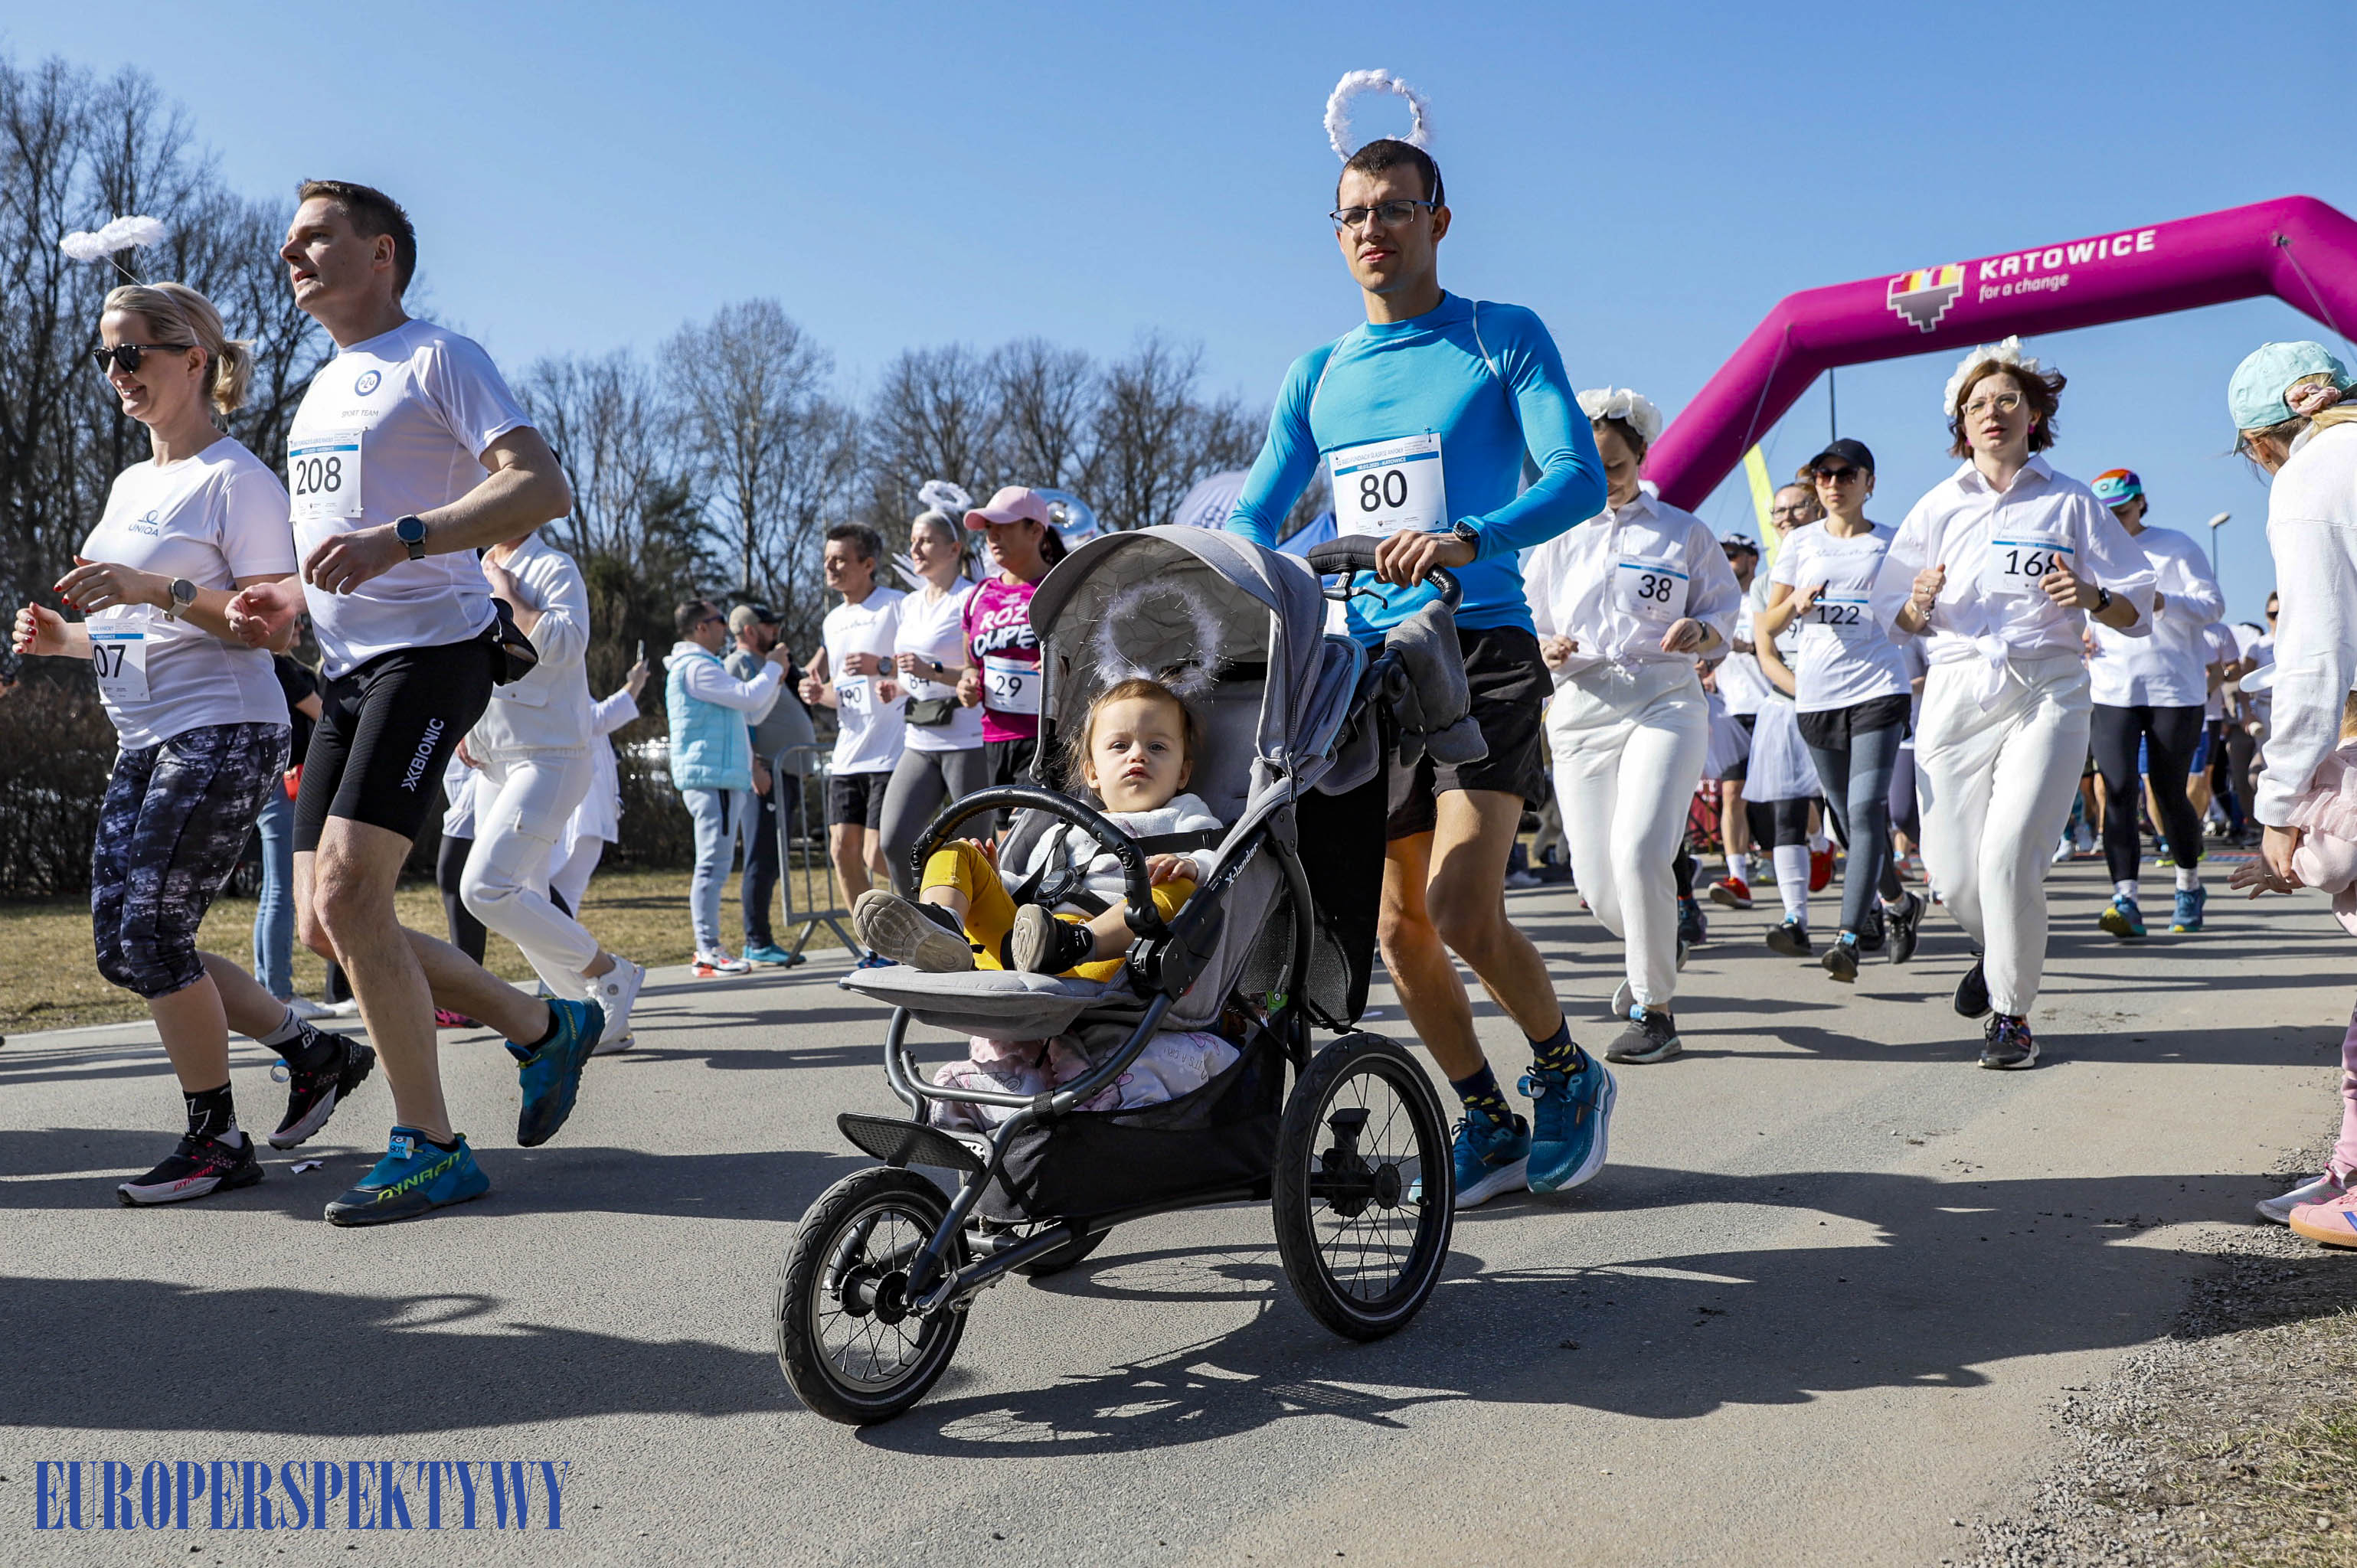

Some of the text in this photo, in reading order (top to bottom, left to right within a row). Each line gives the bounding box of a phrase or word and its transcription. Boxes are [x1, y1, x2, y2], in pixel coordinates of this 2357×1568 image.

[1979, 230, 2156, 280] KATOWICE
[1979, 273, 2068, 304] for a change
[361, 409, 380, 417] TEAM
[296, 456, 342, 496] 208
[1360, 469, 1407, 512] 80
[129, 523, 159, 536] UNIQA
[2004, 549, 2059, 577] 168
[1638, 574, 1672, 603] 38
[1817, 605, 1859, 625] 122
[995, 675, 1022, 697] 29
[1225, 842, 1258, 887] X-lander
[174, 1165, 214, 1191] DYNAFIT
[377, 1151, 461, 1204] DYNAFIT
